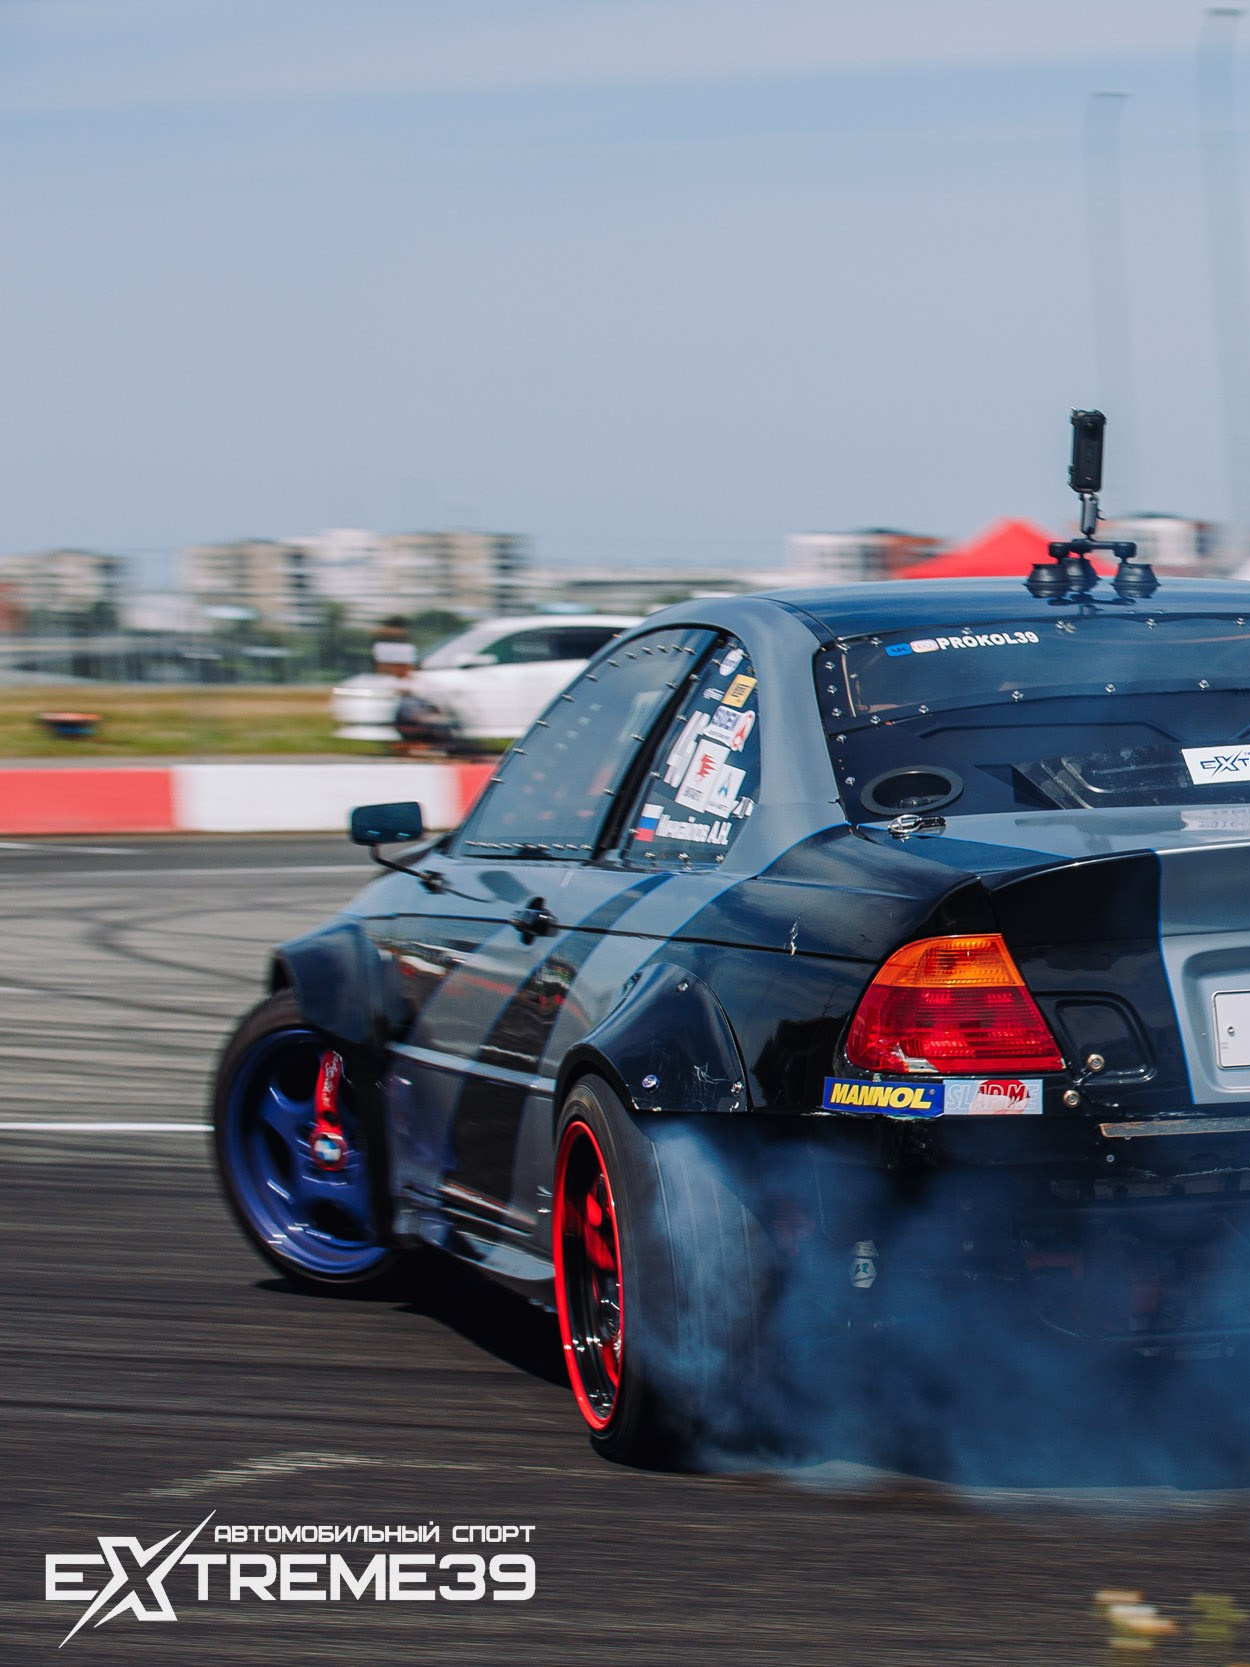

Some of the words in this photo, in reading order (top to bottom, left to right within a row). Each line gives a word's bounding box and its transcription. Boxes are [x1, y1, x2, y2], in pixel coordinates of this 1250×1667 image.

[935, 630, 1040, 650] PROKOL39
[830, 1083, 933, 1109] MANNOL
[946, 1084, 1006, 1110] SLAP
[1007, 1084, 1039, 1110] ME
